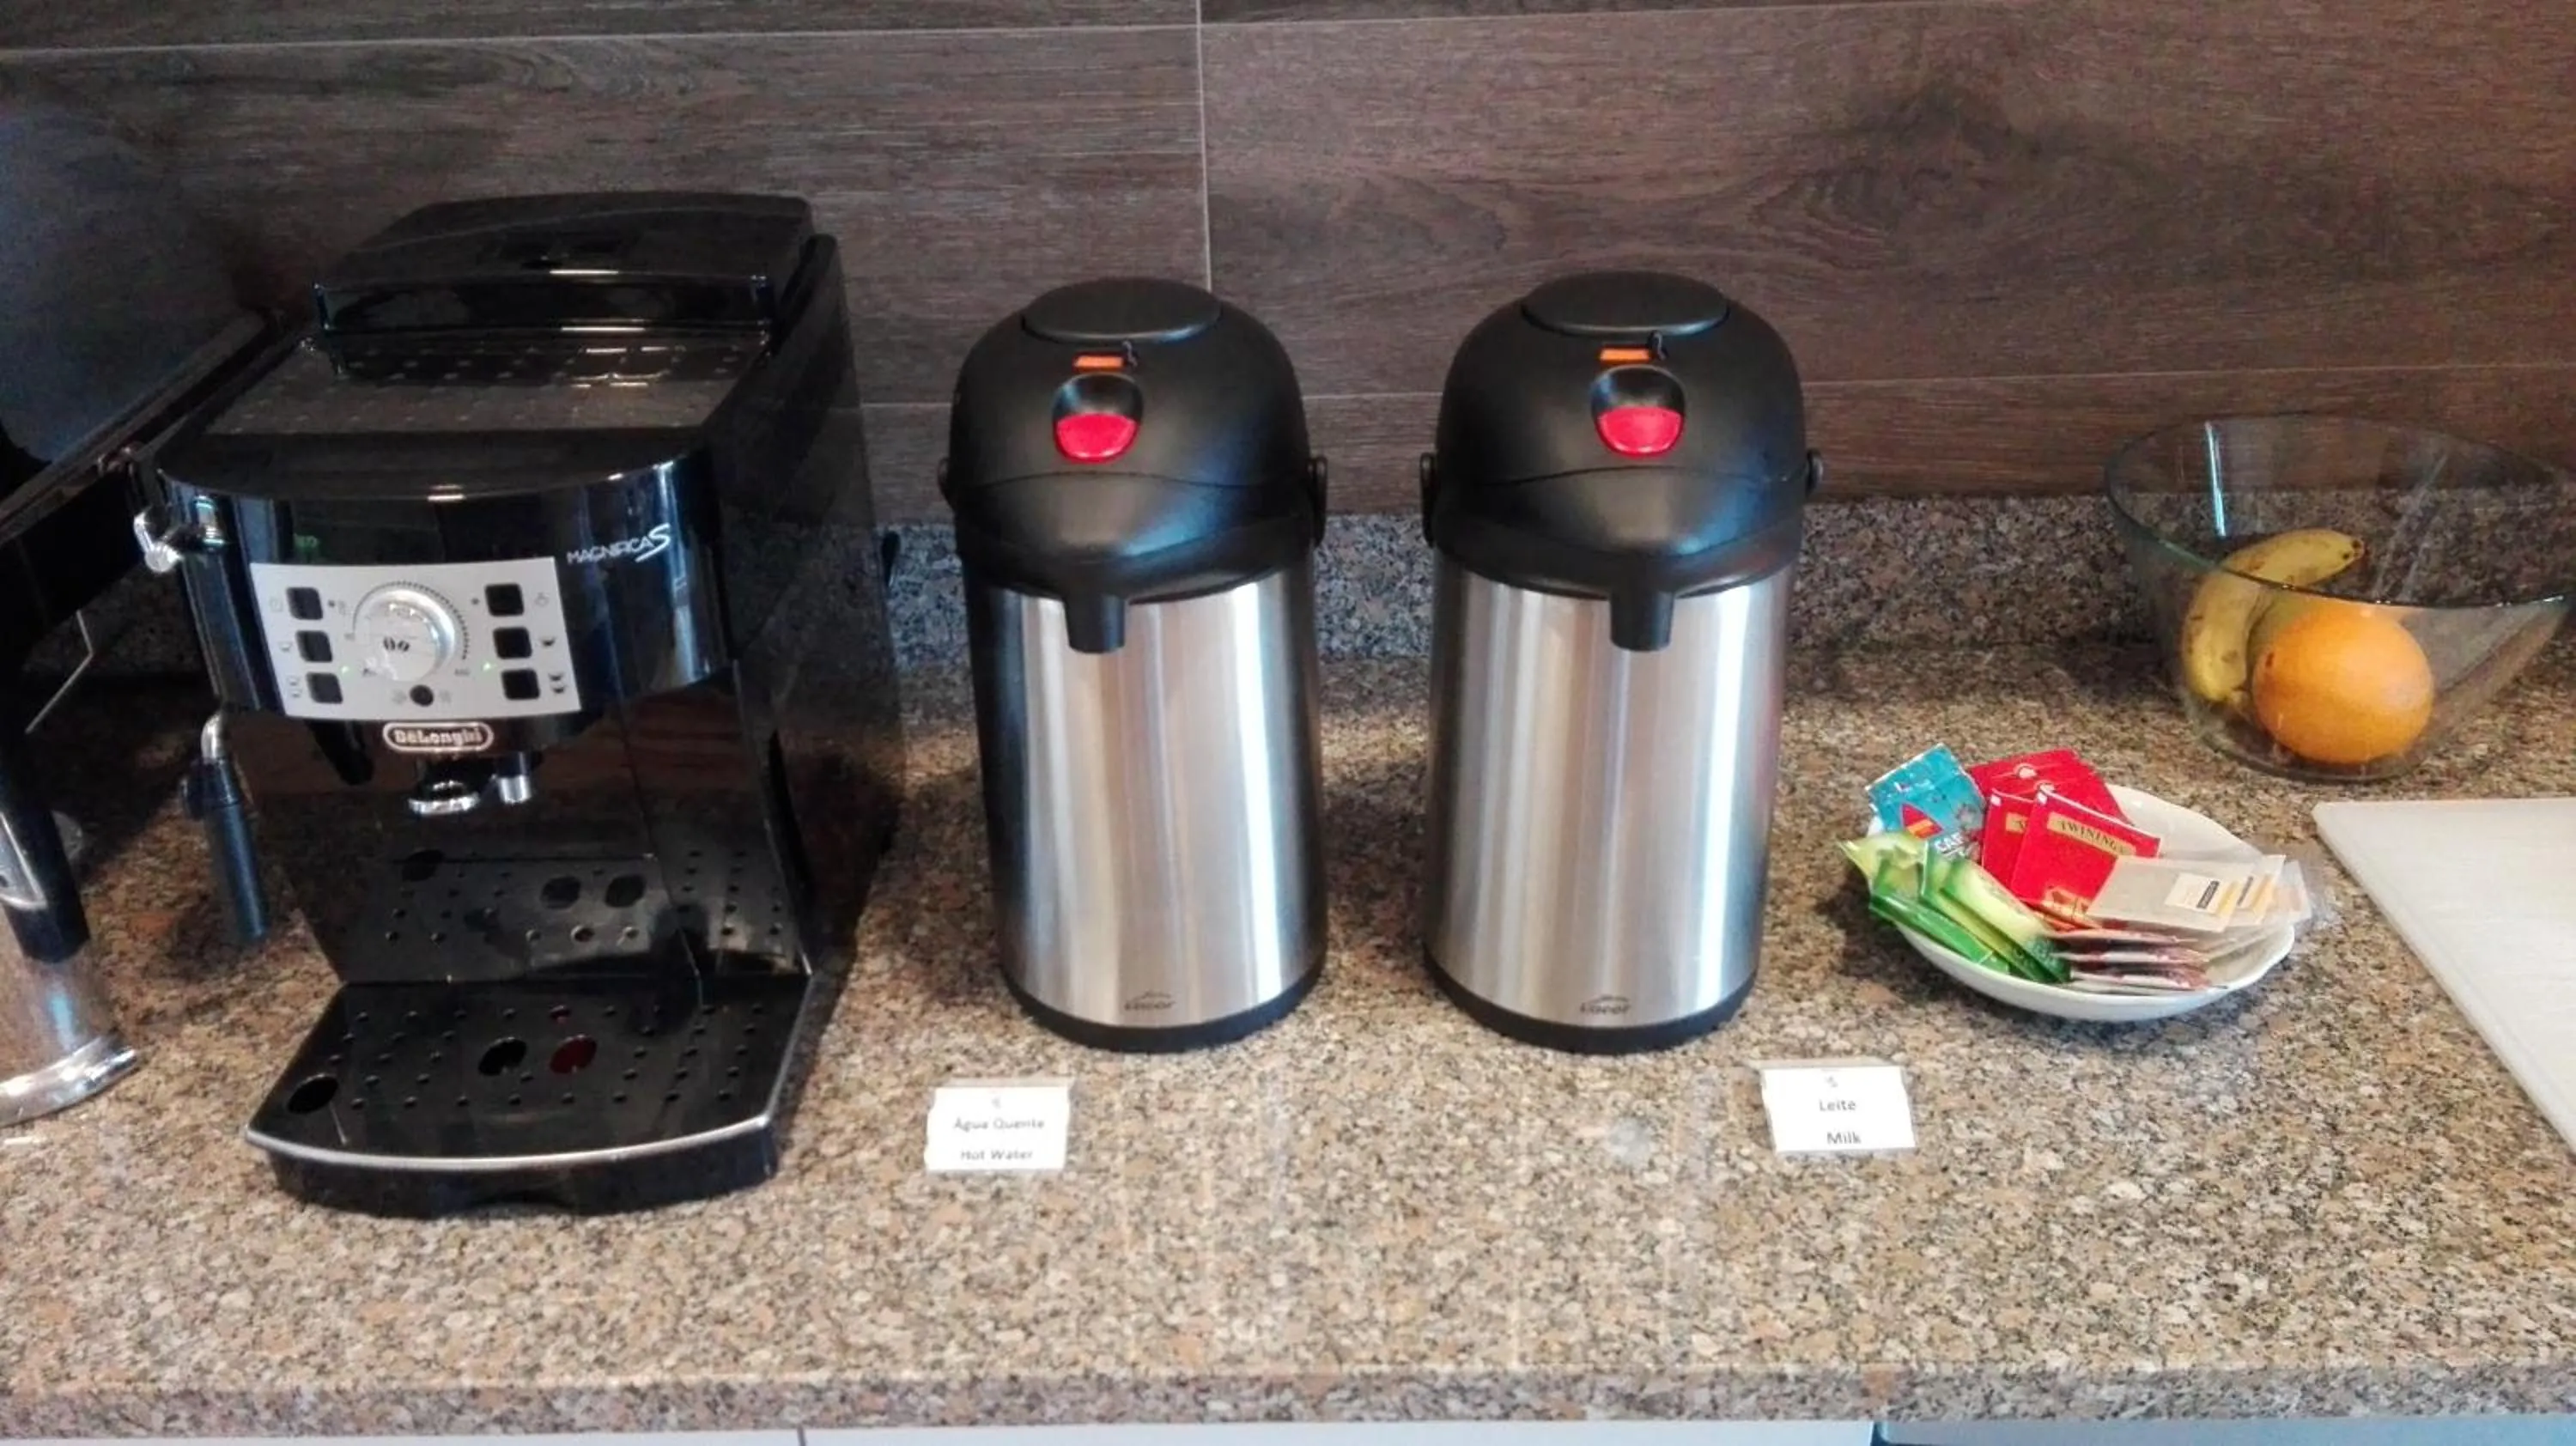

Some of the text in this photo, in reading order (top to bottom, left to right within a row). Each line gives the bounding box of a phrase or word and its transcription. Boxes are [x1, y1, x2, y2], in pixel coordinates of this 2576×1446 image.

[394, 728, 483, 746] DeLonghi
[1819, 1098, 1856, 1112] Leite
[993, 1117, 1045, 1130] Quente
[1826, 1131, 1862, 1145] Milk
[960, 1149, 1033, 1161] Hot Water
